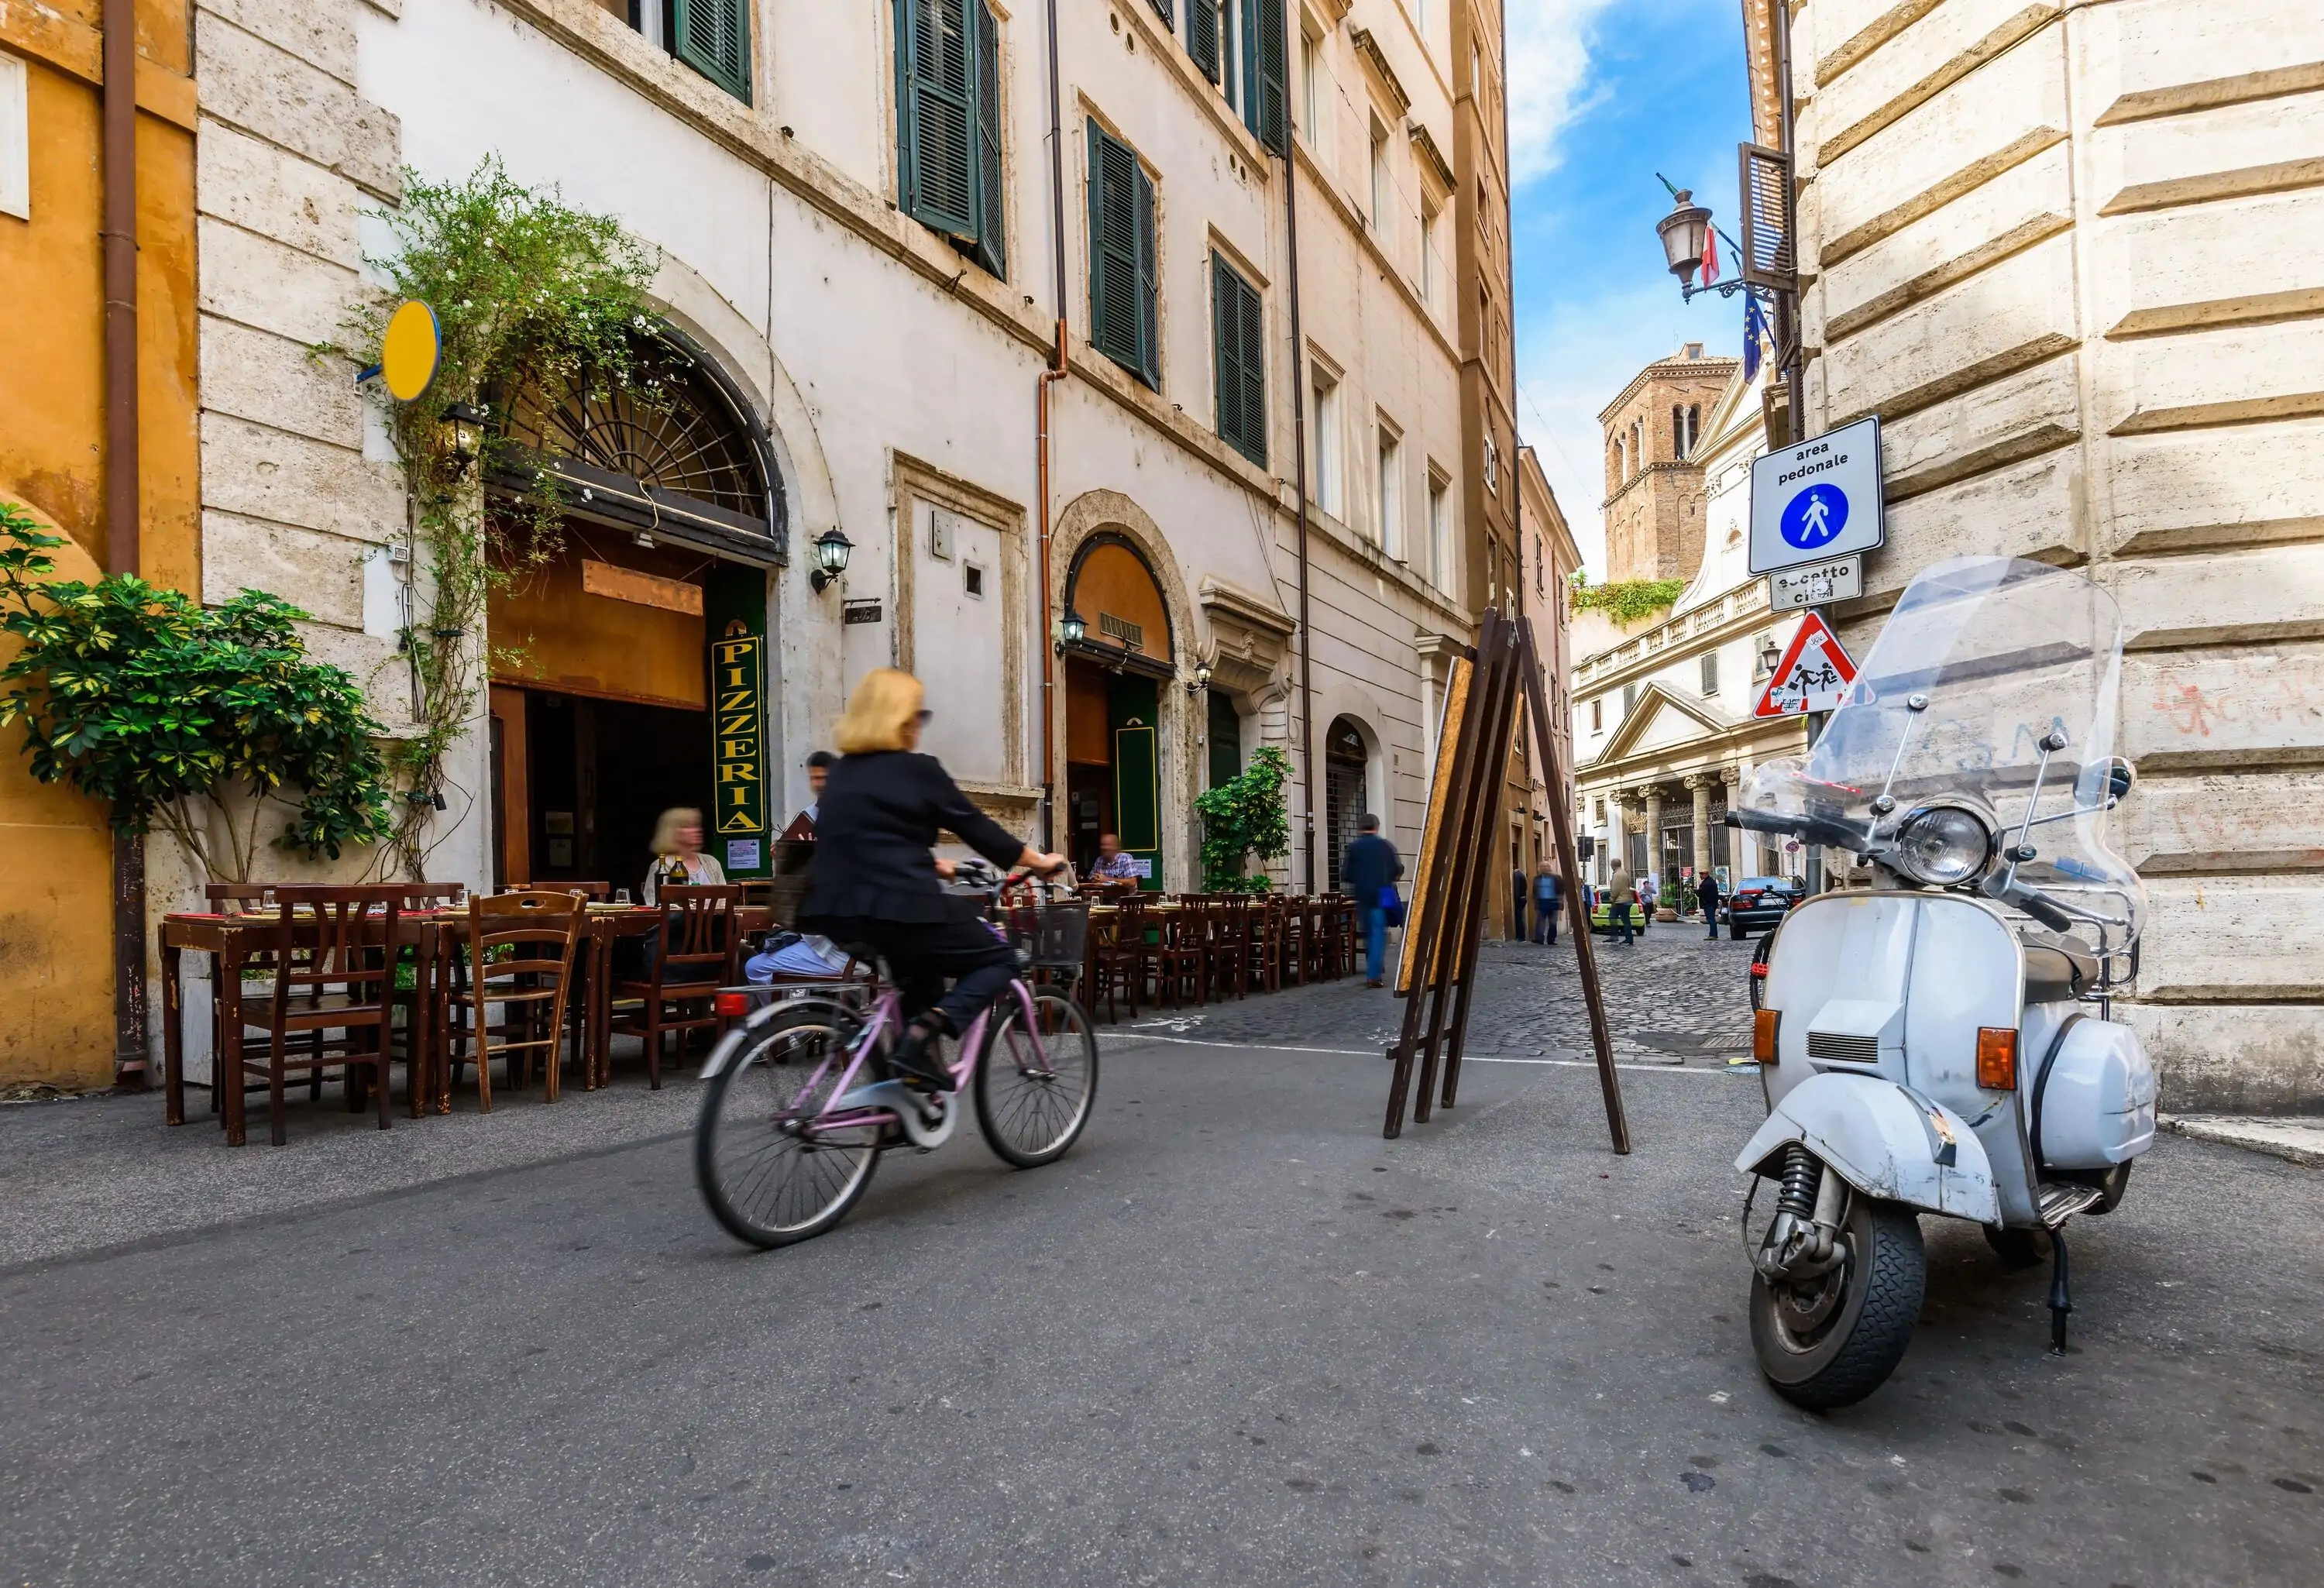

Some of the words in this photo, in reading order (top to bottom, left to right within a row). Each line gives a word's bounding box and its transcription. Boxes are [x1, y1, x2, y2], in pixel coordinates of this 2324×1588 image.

[1796, 442, 1829, 461] area
[1779, 453, 1848, 486] pedonale
[718, 644, 761, 830] PIZZERIA
